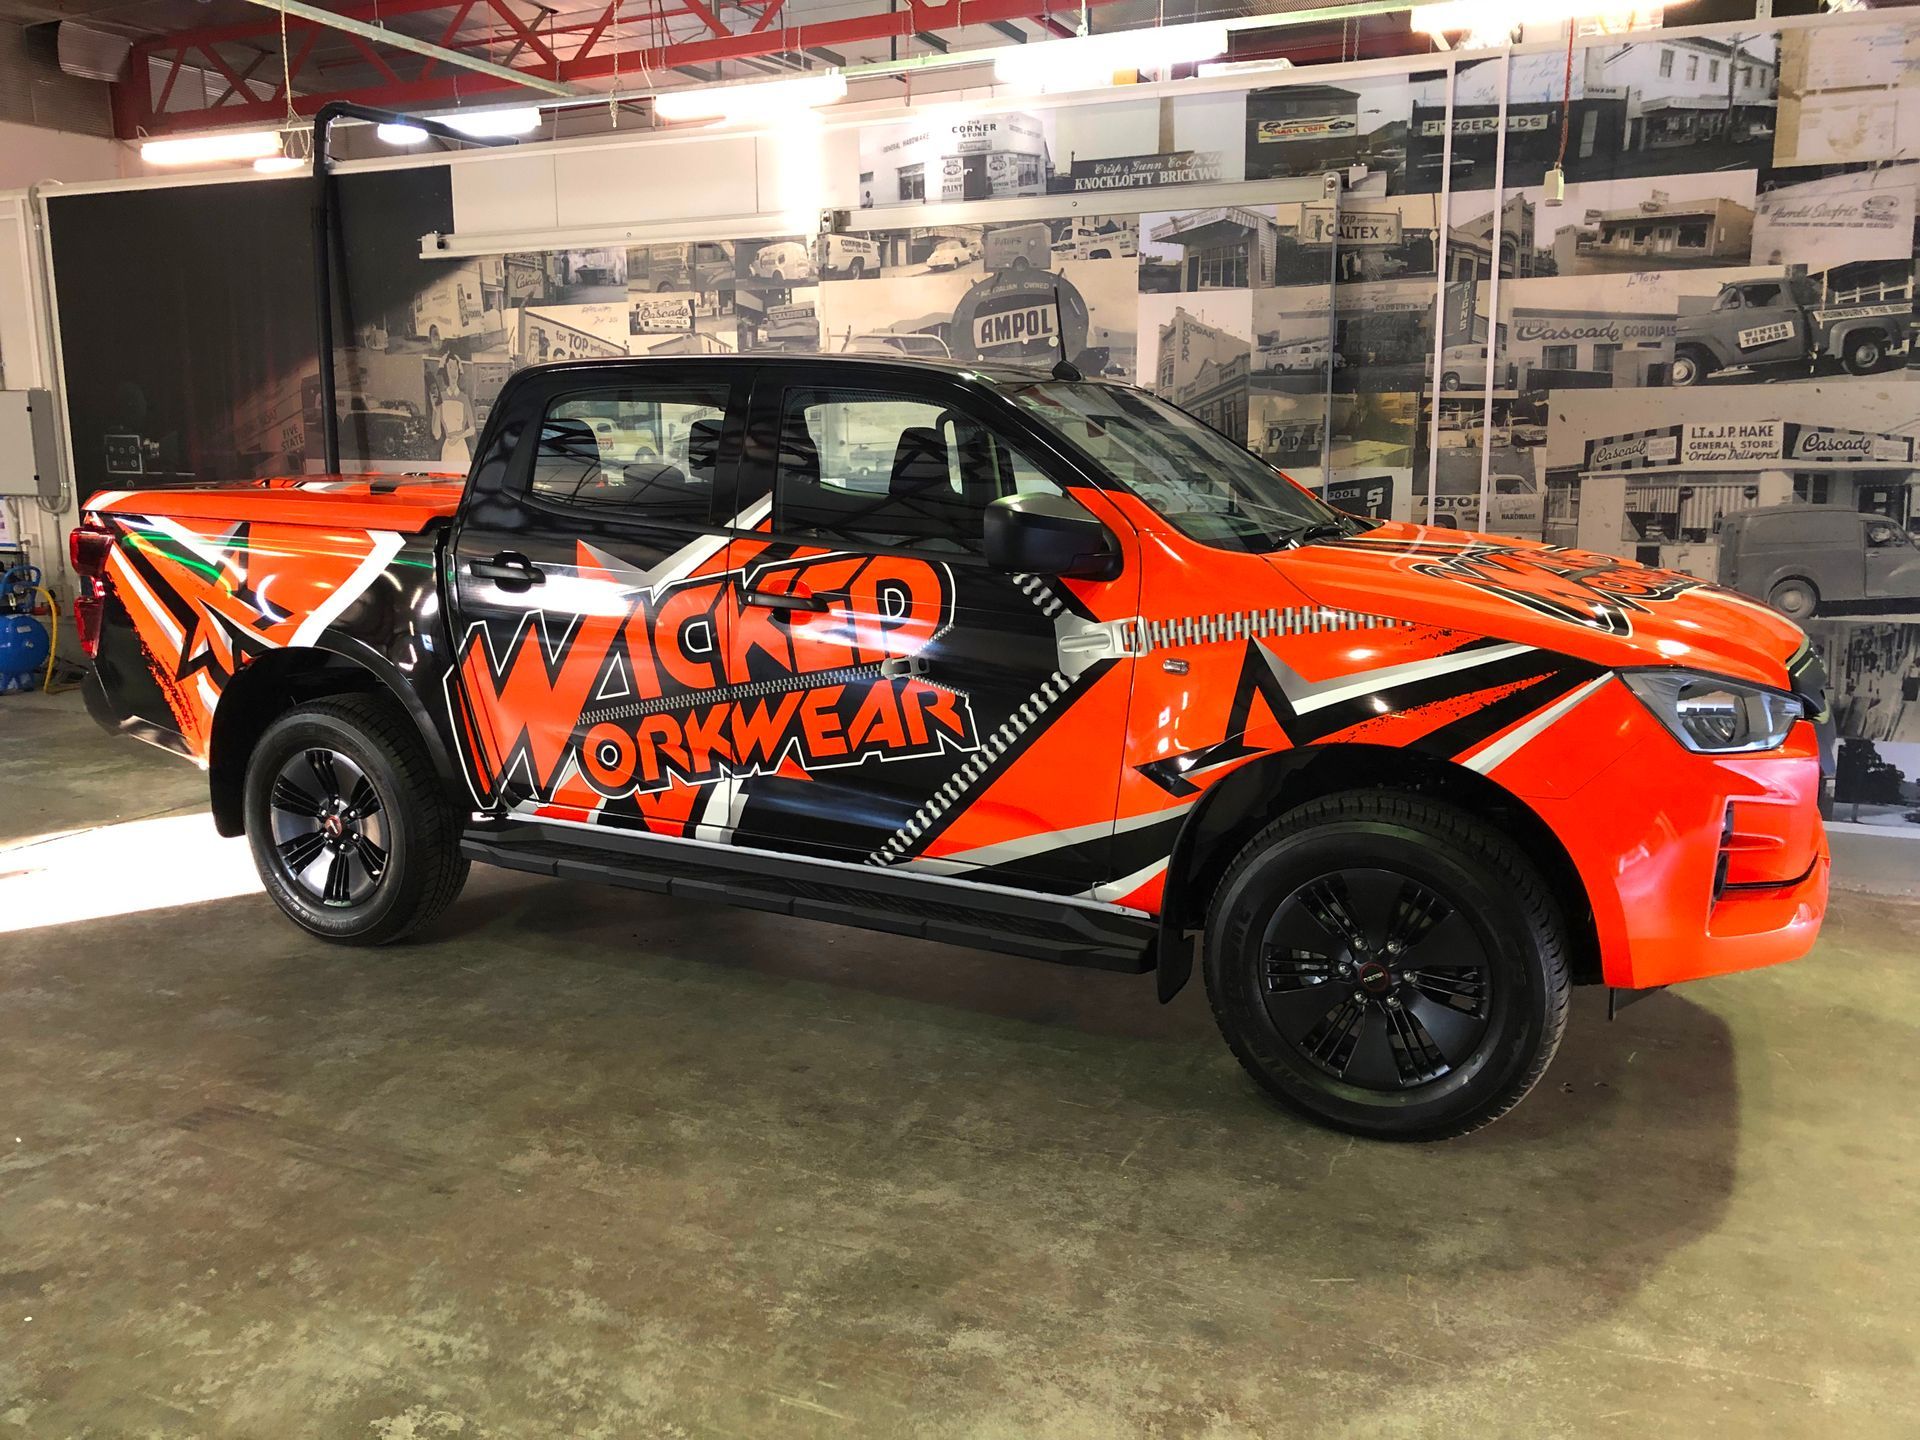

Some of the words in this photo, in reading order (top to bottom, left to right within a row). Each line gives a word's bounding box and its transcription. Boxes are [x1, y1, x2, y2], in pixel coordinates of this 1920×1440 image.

[952, 123, 997, 133] CORNER
[1427, 117, 1540, 132] FIZGERLDS
[942, 184, 963, 193] PAINT
[1074, 172, 1154, 191] KNOCKLOFTY
[1480, 204, 1516, 225] KOAK
[1325, 224, 1379, 239] CALTEX
[1459, 280, 1471, 331] SIGNS
[640, 306, 689, 321] Cascade
[981, 309, 1053, 344] AMPOL
[1182, 320, 1216, 340] KODAK
[1516, 321, 1620, 342] Cascade
[1623, 325, 1678, 338] CORDIALS
[1744, 323, 1788, 338] WINTER
[555, 330, 567, 343] for
[568, 333, 589, 352] TOP
[1744, 331, 1789, 346] TREADS
[1739, 425, 1774, 438] HAKE
[1689, 440, 1735, 450] GENERAL
[1740, 440, 1773, 449] STORE
[1802, 432, 1872, 454] Cascade
[1596, 439, 1647, 463] Cascade
[1688, 450, 1727, 461] Orders
[1727, 448, 1780, 461] Delivered
[1501, 513, 1536, 521] HARDWARE
